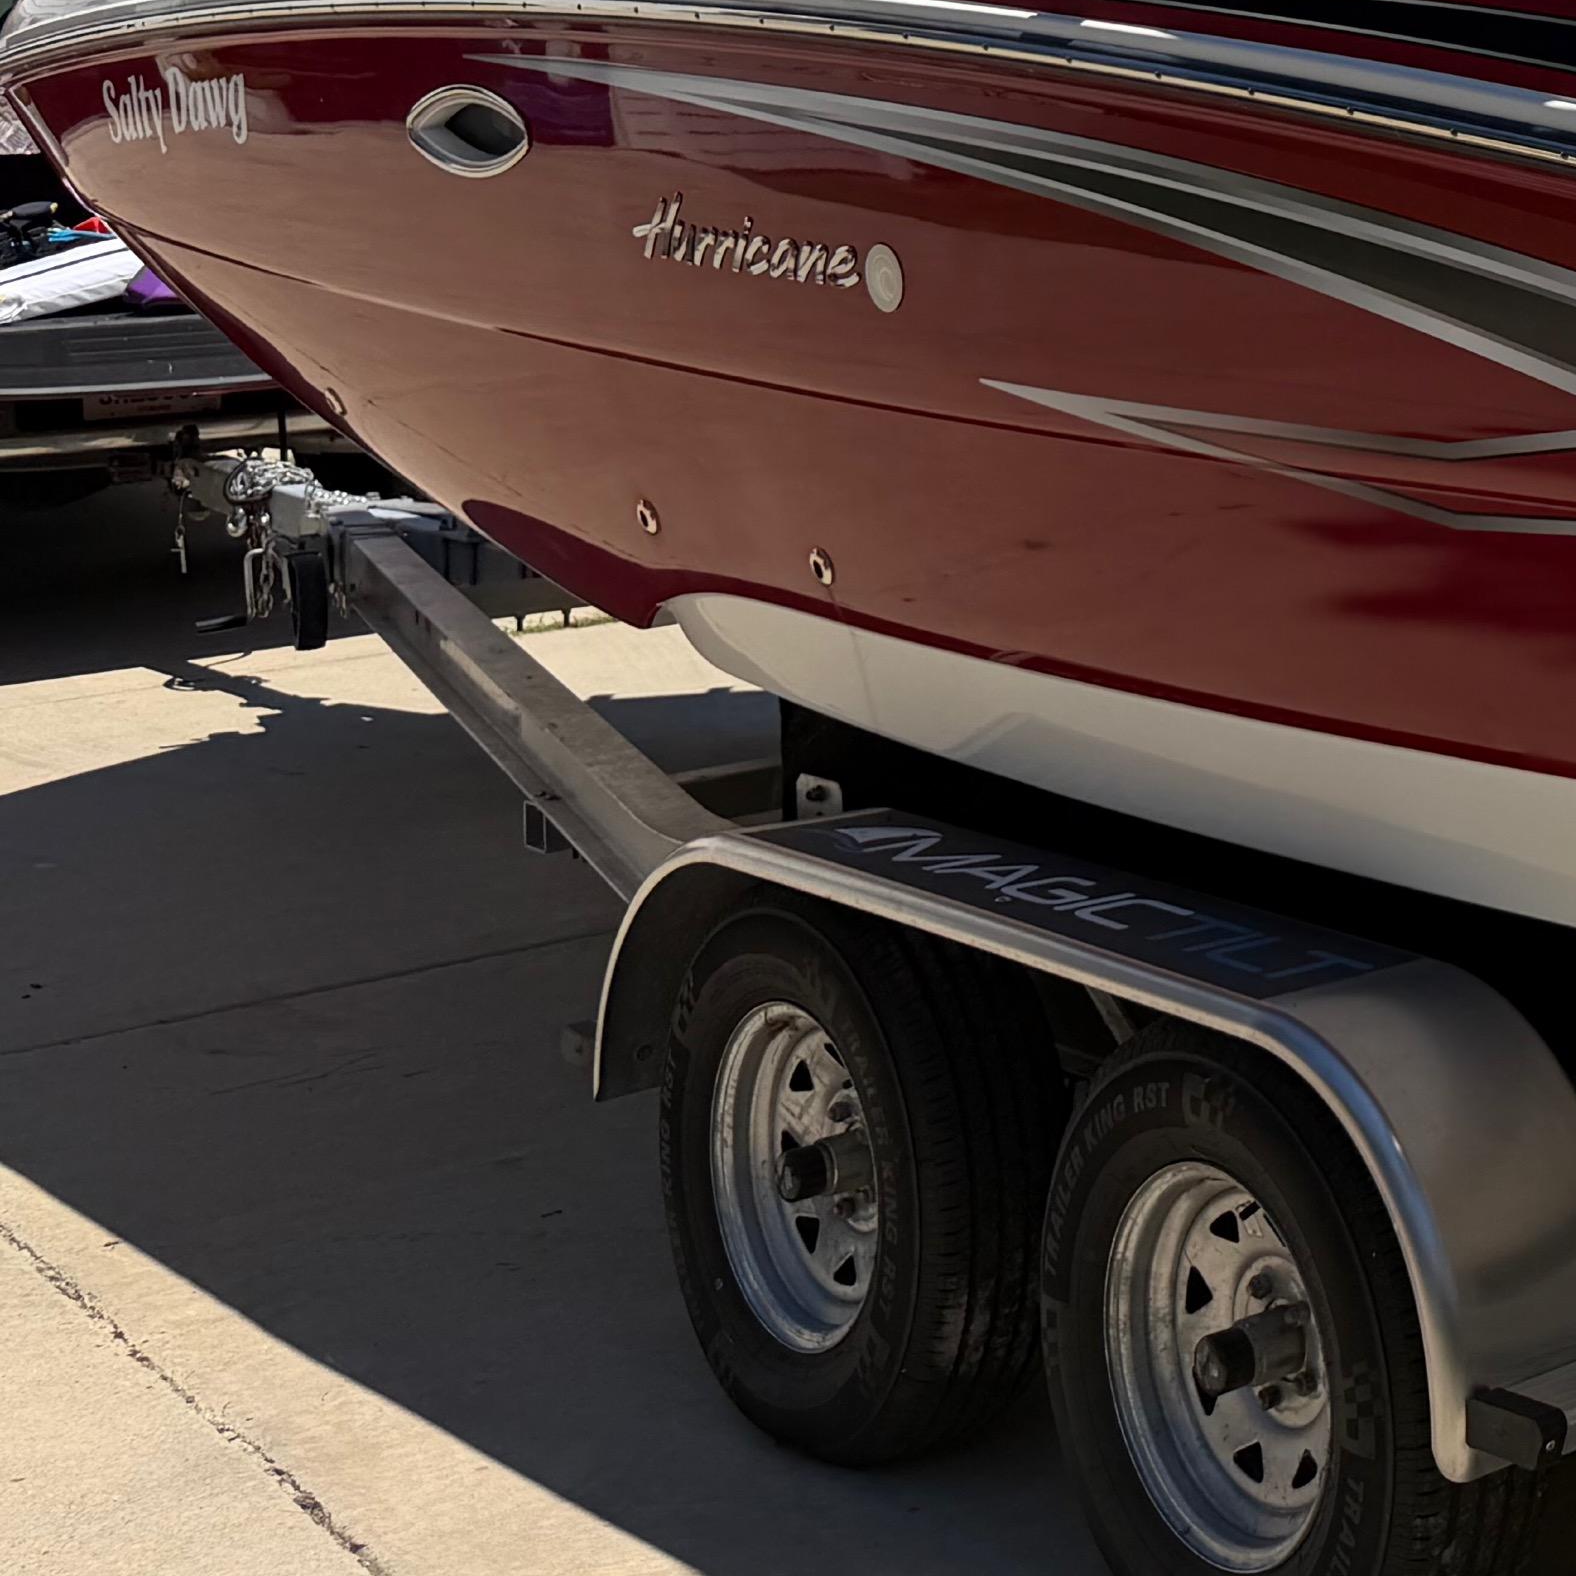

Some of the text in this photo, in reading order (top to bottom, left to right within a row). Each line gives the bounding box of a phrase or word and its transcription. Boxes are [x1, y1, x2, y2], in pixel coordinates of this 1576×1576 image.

[102, 66, 249, 155] Salty Dawg
[632, 190, 862, 289] Hurricane
[1045, 1081, 1170, 1278] TRAILER KING RST
